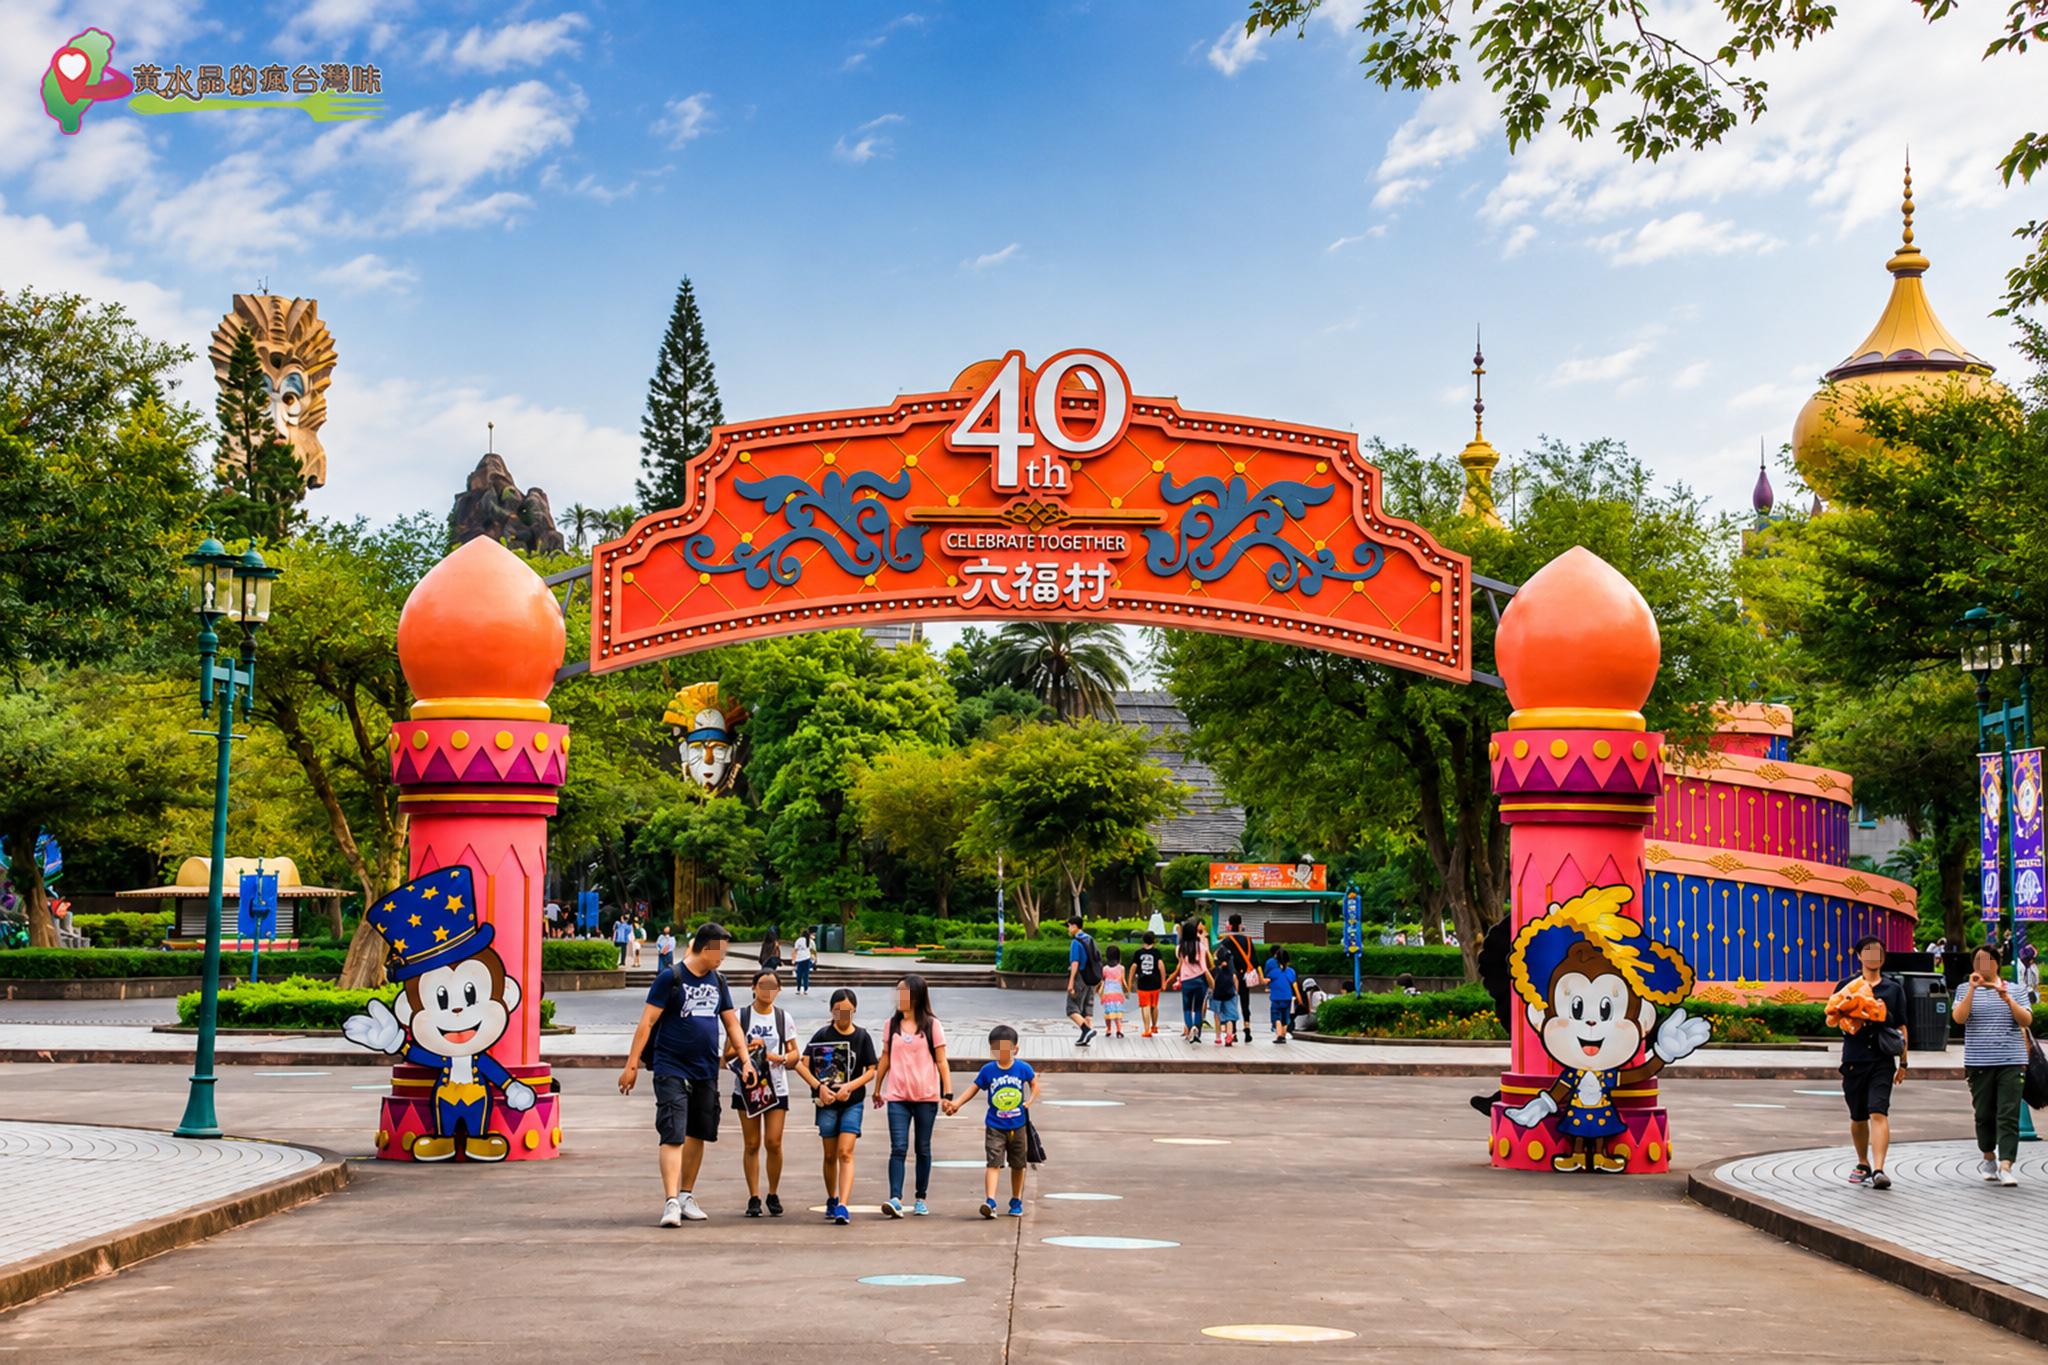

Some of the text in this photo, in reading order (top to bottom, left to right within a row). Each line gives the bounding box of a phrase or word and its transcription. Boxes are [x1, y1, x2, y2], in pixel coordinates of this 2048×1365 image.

[946, 532, 1127, 551] CELEBRATE TOGETHER
[961, 558, 1111, 603] 六福村
